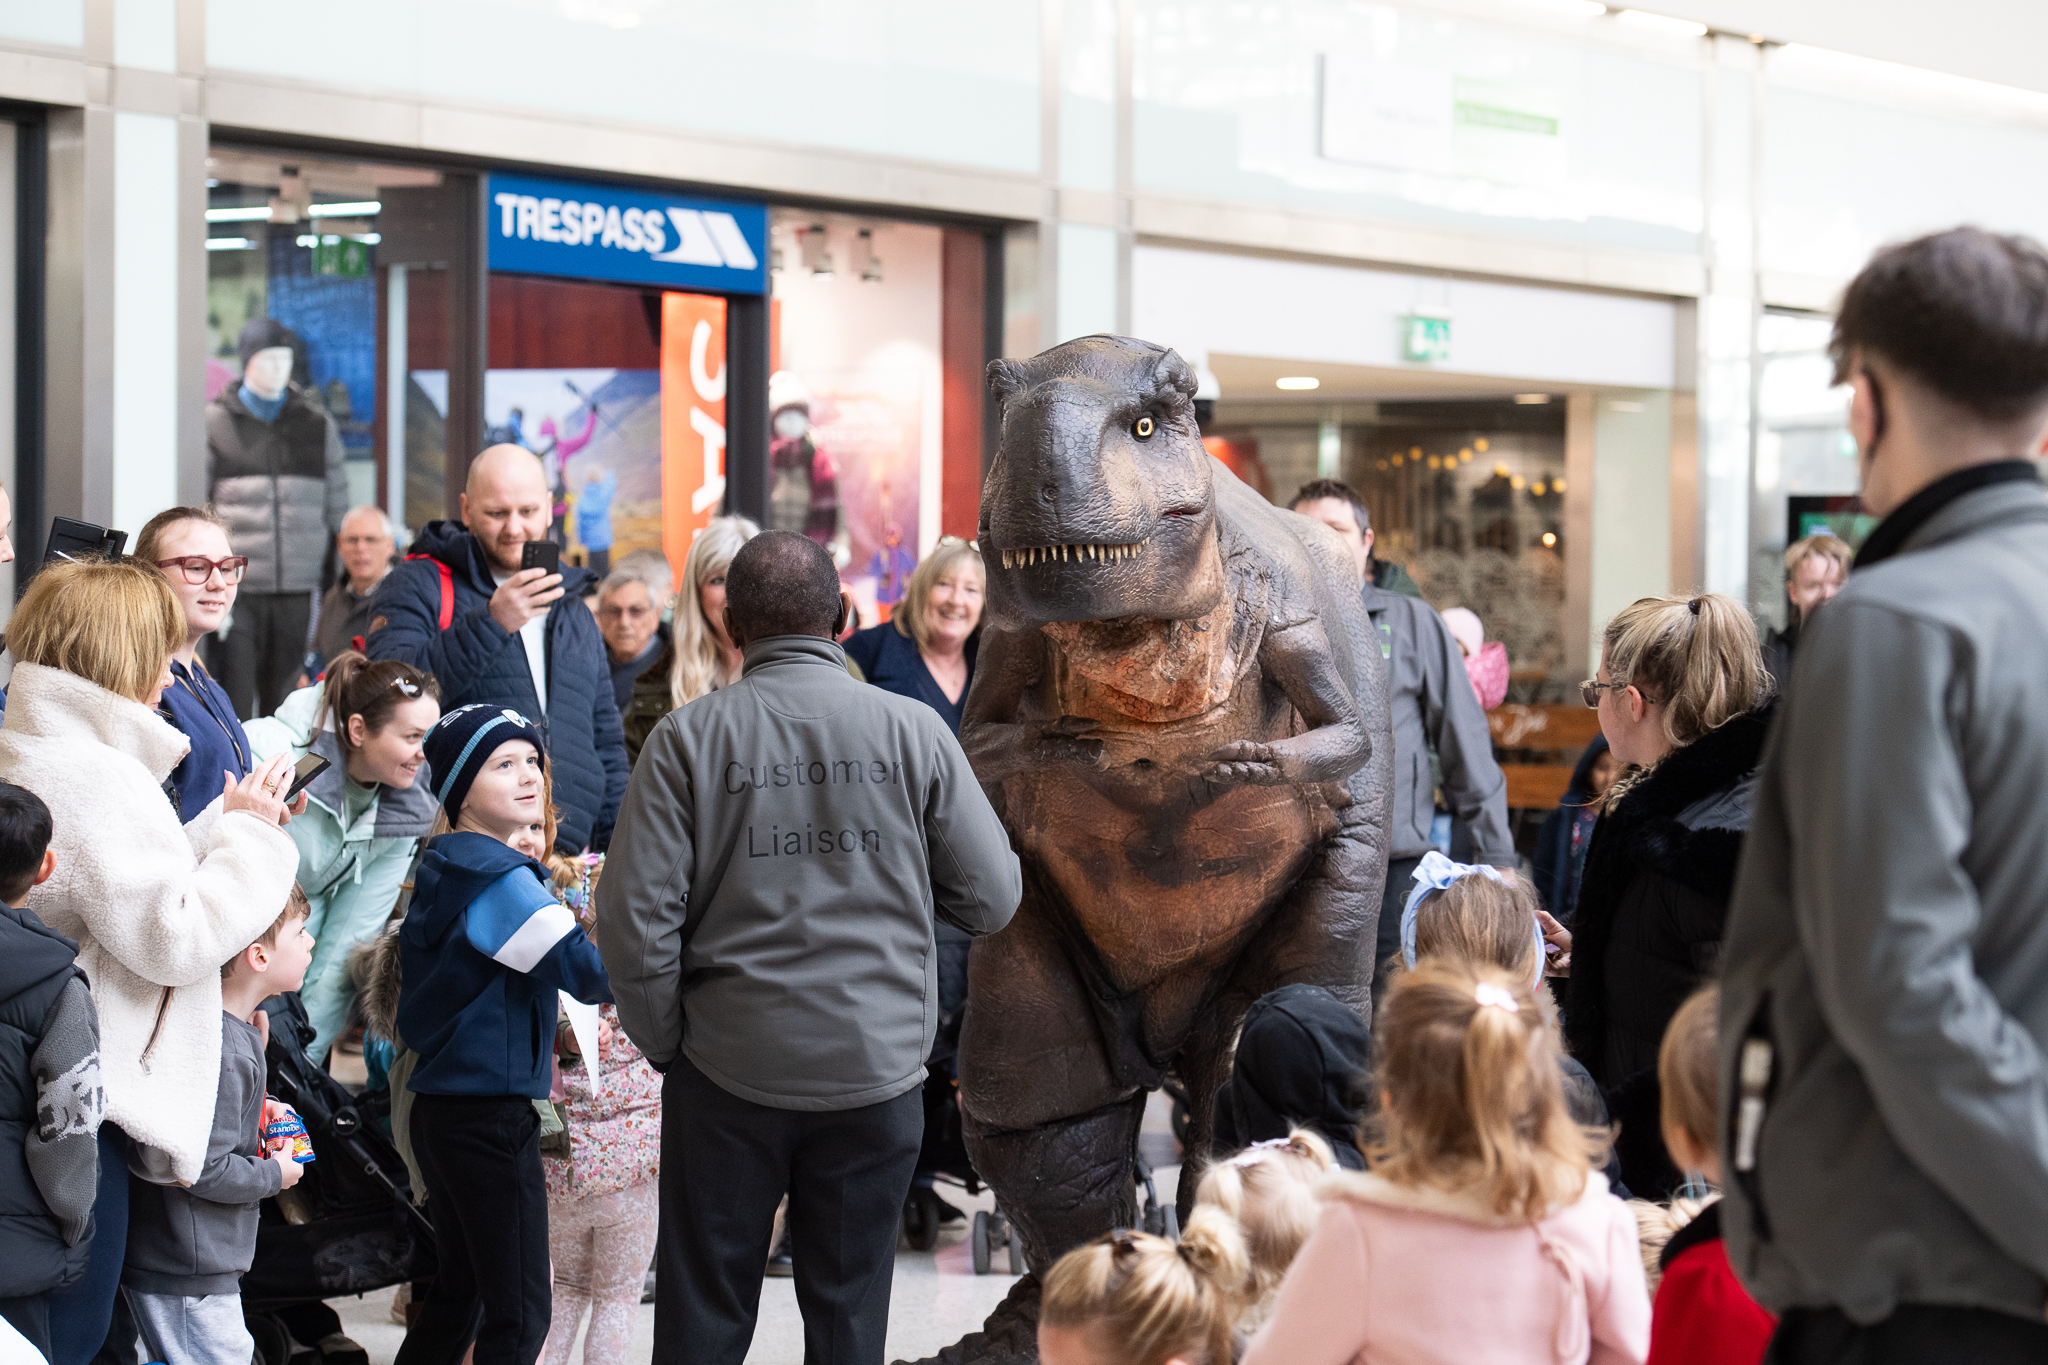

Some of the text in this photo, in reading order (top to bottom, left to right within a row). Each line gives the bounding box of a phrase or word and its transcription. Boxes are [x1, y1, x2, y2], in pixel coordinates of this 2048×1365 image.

[495, 192, 667, 254] TRESPASS
[723, 755, 903, 796] Customer
[747, 822, 881, 859] Liaison
